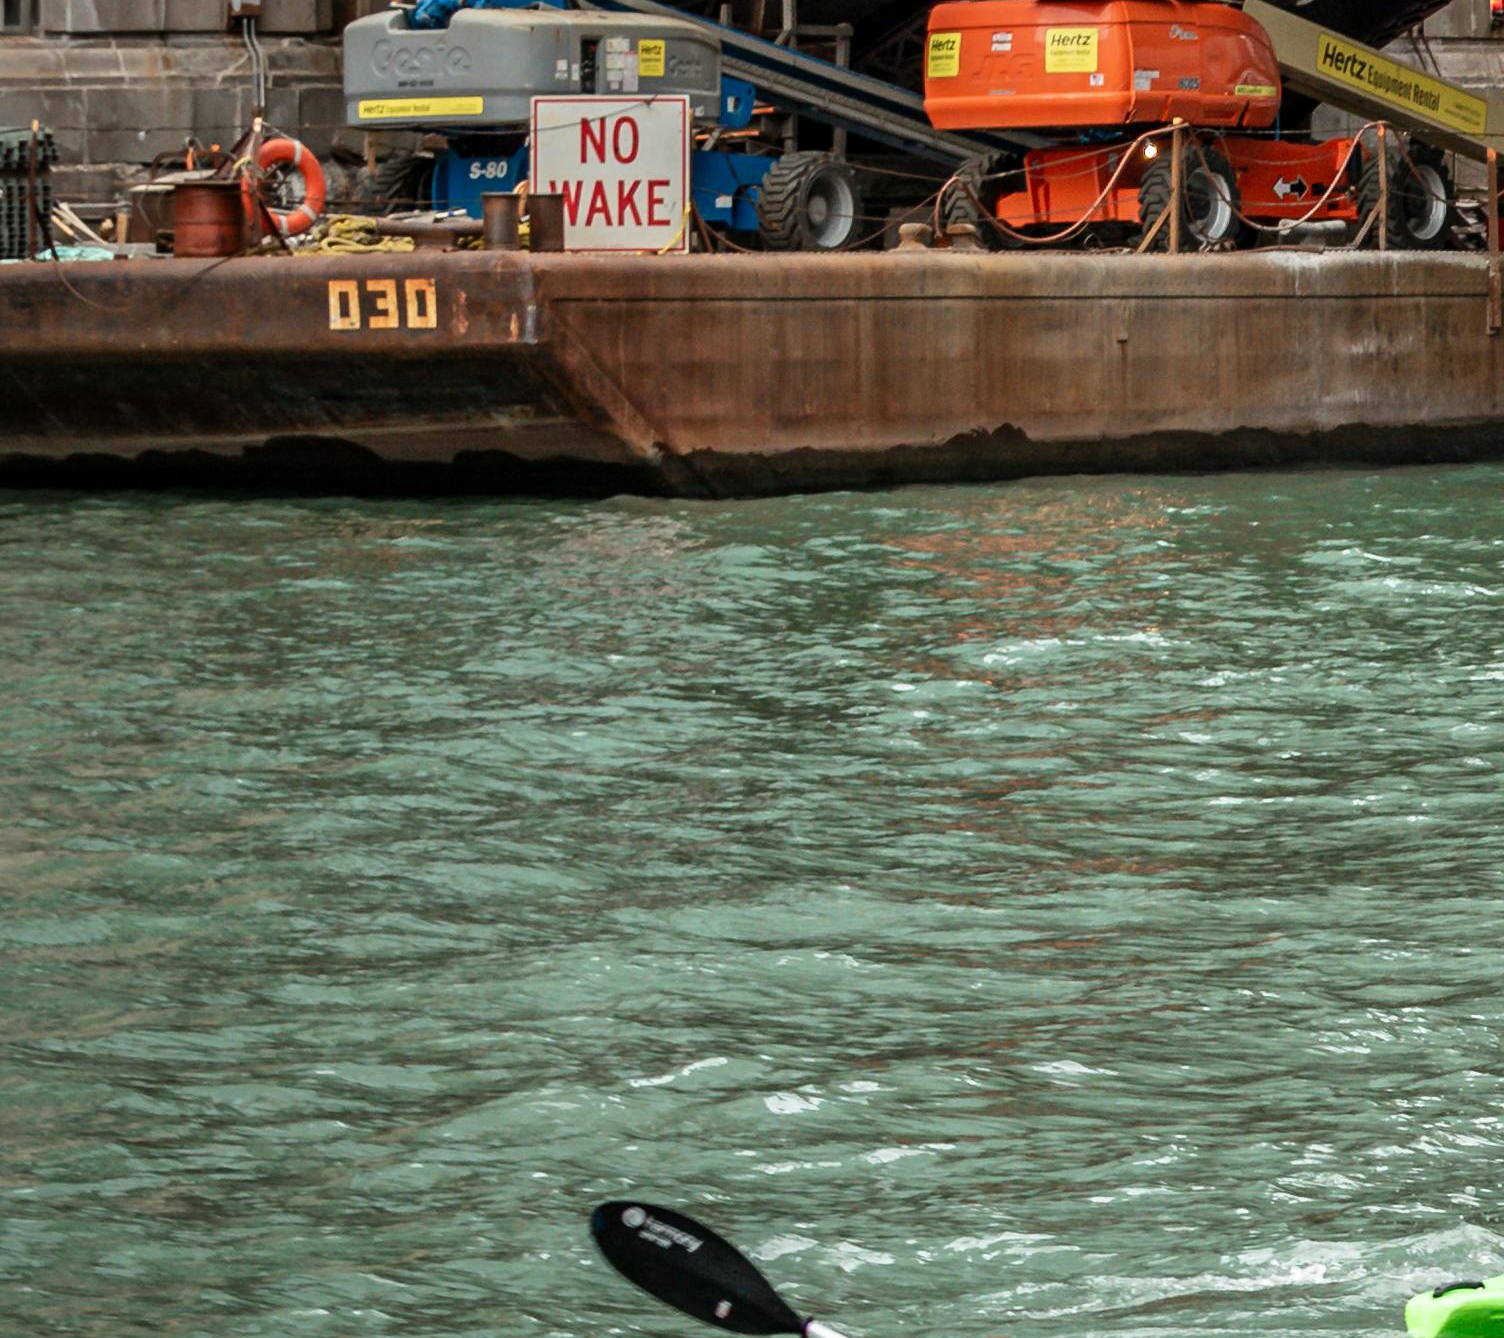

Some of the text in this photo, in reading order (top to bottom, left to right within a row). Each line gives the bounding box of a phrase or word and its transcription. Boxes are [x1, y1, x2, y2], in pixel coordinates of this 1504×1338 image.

[931, 39, 956, 51] Hertz
[1050, 33, 1092, 47] Hertz
[1322, 42, 1367, 79] Hertz
[1412, 83, 1440, 111] Rental
[580, 116, 639, 165] NO
[469, 161, 508, 179] S-80
[550, 179, 671, 227] WAKE
[328, 278, 437, 330] 030
